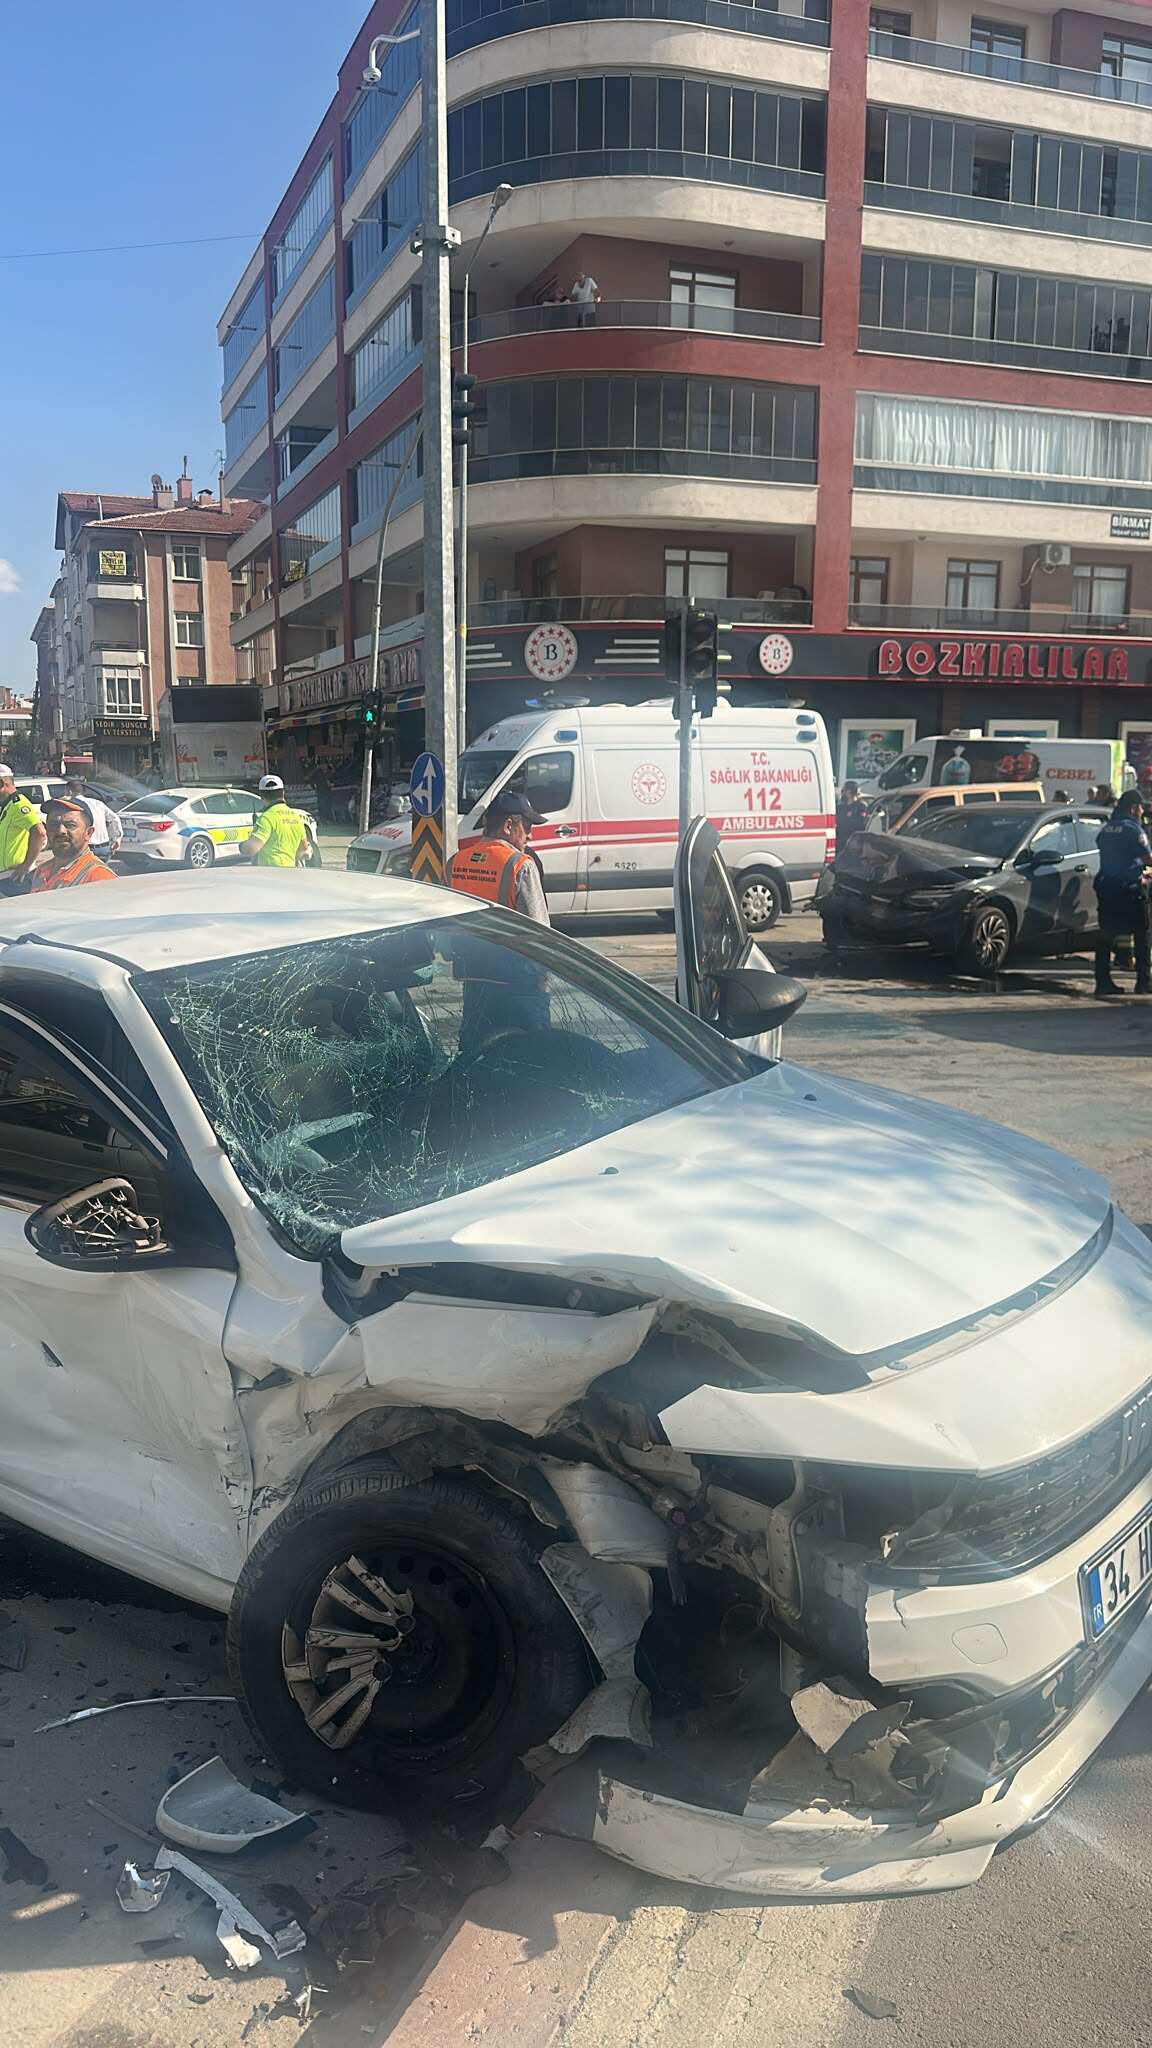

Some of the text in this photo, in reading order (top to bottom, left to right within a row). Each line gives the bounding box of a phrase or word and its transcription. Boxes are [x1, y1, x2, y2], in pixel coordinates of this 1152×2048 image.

[544, 643, 558, 660] B
[878, 640, 1128, 681] BOZKIRLILAR
[751, 752, 770, 765] T.C.
[710, 766, 812, 784] SAĞLIK BAKANLIĞI
[1045, 768, 1096, 781] CEBEL
[744, 788, 782, 811] 112
[722, 816, 805, 831] AMBULANS
[1105, 1522, 1152, 1612] 34 H
